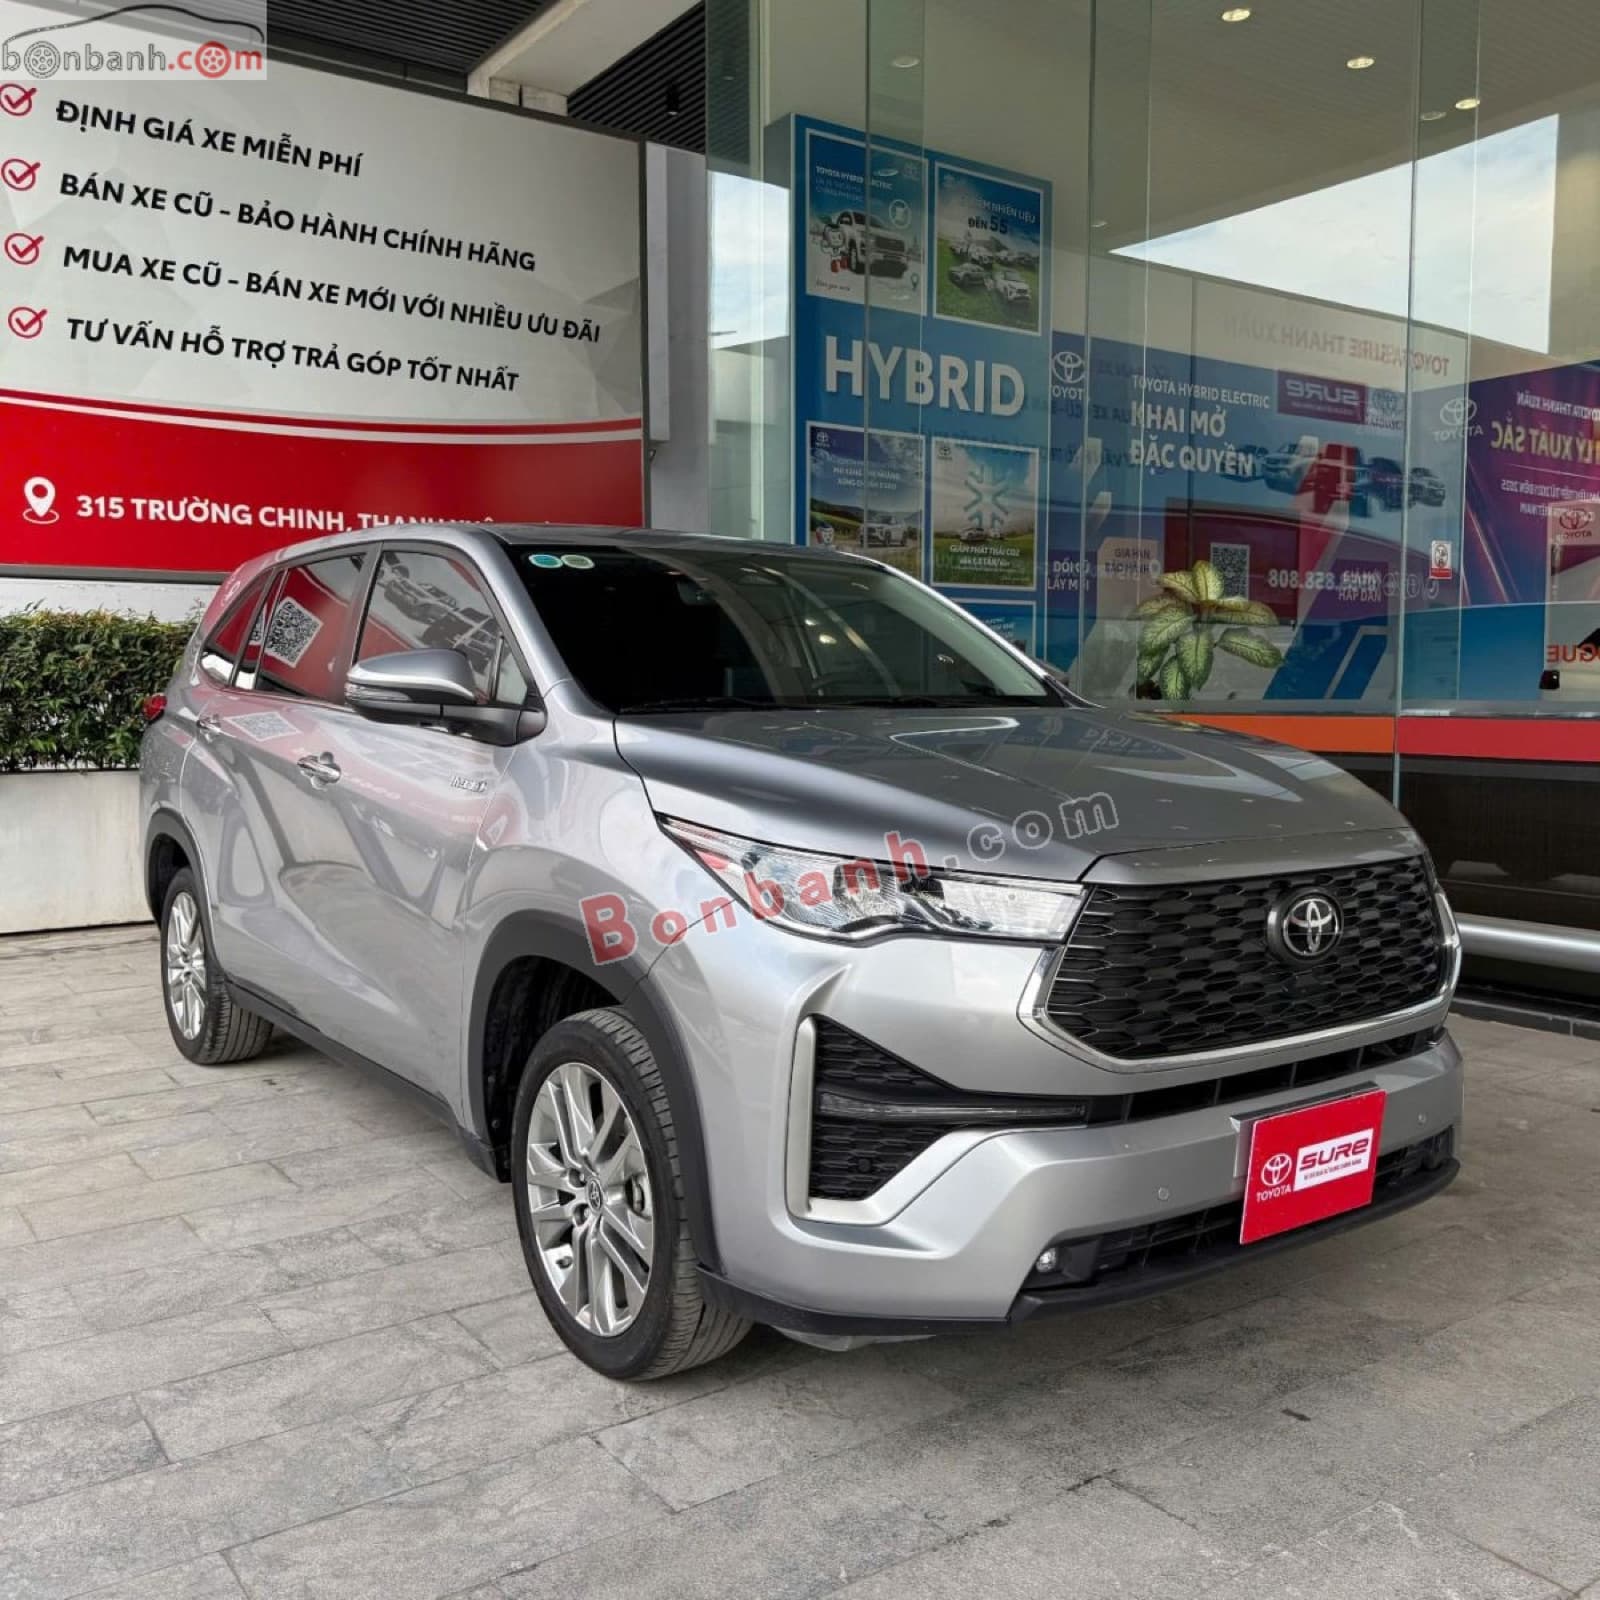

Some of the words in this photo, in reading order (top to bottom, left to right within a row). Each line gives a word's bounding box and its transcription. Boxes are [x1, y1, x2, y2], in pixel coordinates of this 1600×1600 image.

[56, 99, 136, 134] ĐỊNH
[143, 118, 195, 146] GIÁ
[200, 127, 237, 154] XE
[242, 132, 312, 168] MIỄN
[317, 151, 364, 177] PHÍ
[60, 172, 125, 204] BÁN
[131, 184, 168, 210] XE
[174, 190, 214, 218] CŨ
[237, 199, 294, 231] BẢO
[300, 212, 378, 245] HÀNH
[383, 229, 463, 260] CHÍNH
[467, 241, 536, 272] HÃNG
[63, 246, 133, 276] MUA
[140, 256, 177, 281] XE
[182, 261, 222, 288] CŨ
[245, 270, 302, 299] BÁN
[307, 281, 340, 305] XE
[345, 286, 396, 312] MỚI
[402, 294, 444, 319] VỚI
[450, 301, 522, 330] NHIỀU
[527, 313, 559, 336] ƯU
[563, 319, 601, 343] ĐÃI
[67, 317, 109, 342] TƯ
[113, 320, 174, 350] VẤN
[180, 325, 224, 356] HỖ
[231, 337, 286, 368] TRỢ
[291, 344, 340, 370] TRẢ
[347, 351, 402, 377] GÓP
[407, 356, 452, 383] TỐT
[456, 365, 520, 392] NHẤT
[824, 335, 1026, 417] HYBRID
[1132, 375, 1176, 395] TOYOTA
[1178, 383, 1220, 401] HYBRID
[1220, 389, 1271, 409] ELECTRIC
[1130, 400, 1185, 433] KHAI
[1190, 404, 1227, 438] MỞ
[1179, 441, 1255, 477] QUYỀN
[76, 495, 124, 519] 315
[131, 497, 253, 526] TRƯỜNG
[258, 507, 352, 533] CHINH,
[1299, 1138, 1369, 1171] SURE
[1256, 1185, 1292, 1203] TOYOTA
